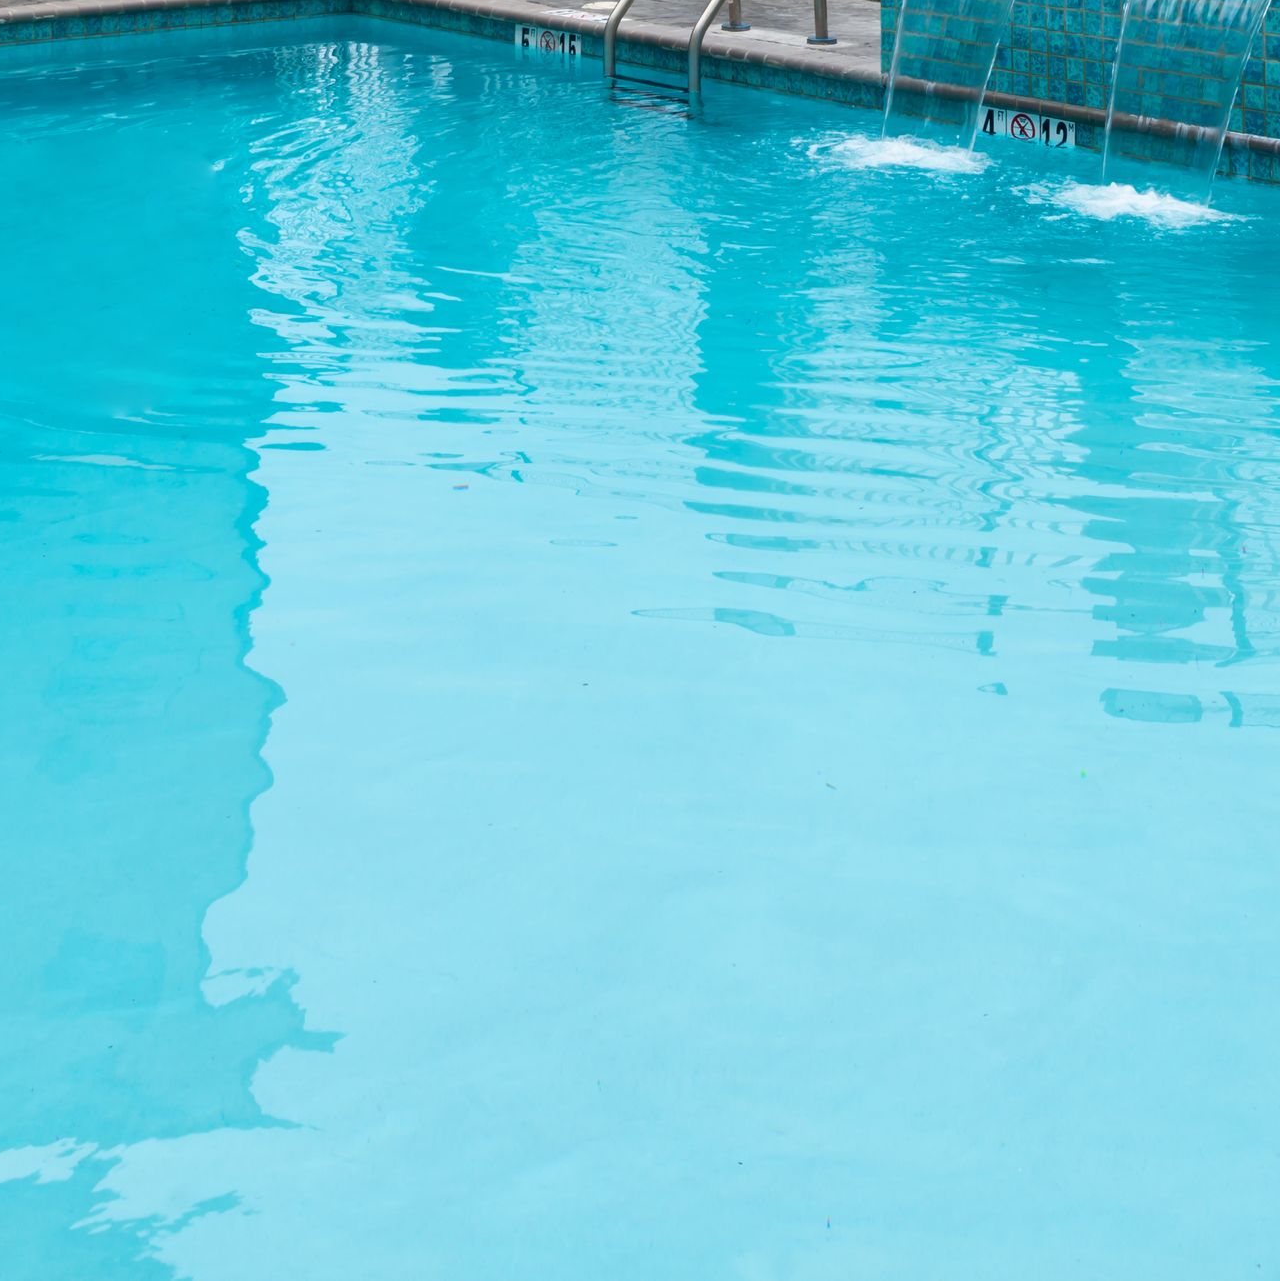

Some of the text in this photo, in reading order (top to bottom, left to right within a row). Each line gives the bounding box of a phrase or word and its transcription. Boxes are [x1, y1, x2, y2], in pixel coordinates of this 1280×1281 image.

[522, 27, 530, 47] 5
[982, 109, 996, 135] 4
[998, 111, 1004, 122] FT
[1068, 124, 1074, 132] M
